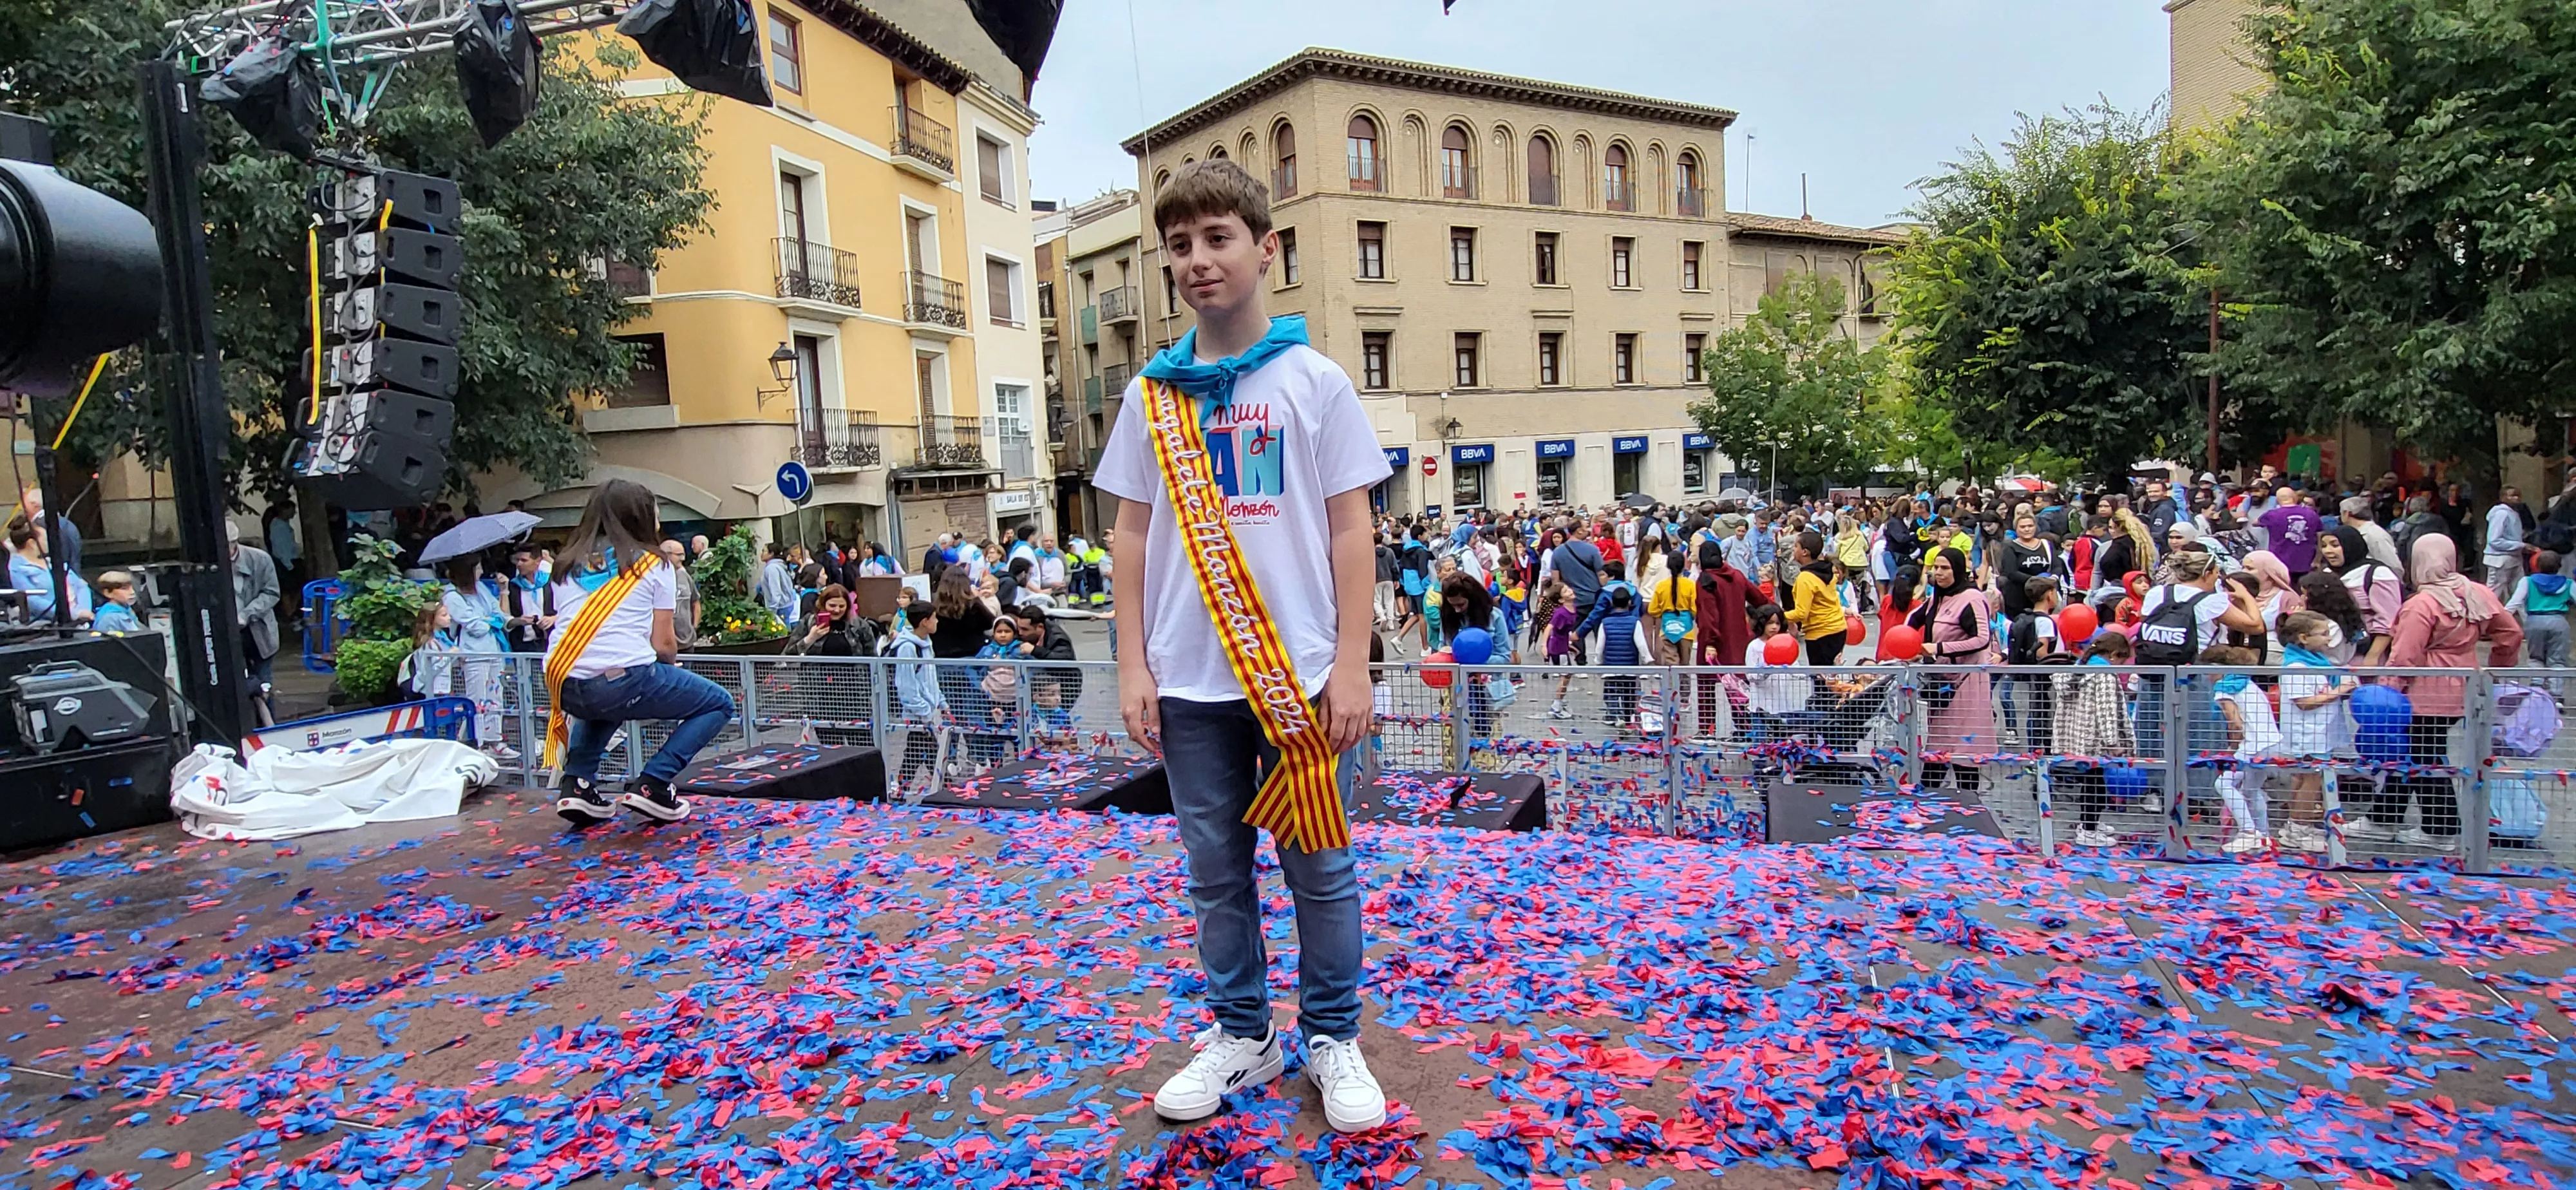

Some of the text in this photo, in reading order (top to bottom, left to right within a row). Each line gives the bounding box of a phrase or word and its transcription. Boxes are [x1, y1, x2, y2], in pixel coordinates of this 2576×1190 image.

[1620, 439, 1642, 449] BBVA
[1690, 435, 1710, 446] BBVA
[1461, 448, 1486, 458] BBVA
[1544, 443, 1567, 454] BBVA
[1205, 425, 1285, 496] AN
[1193, 508, 1260, 658] Monzón
[1255, 668, 1310, 733] 2024
[2142, 623, 2187, 645] VANS
